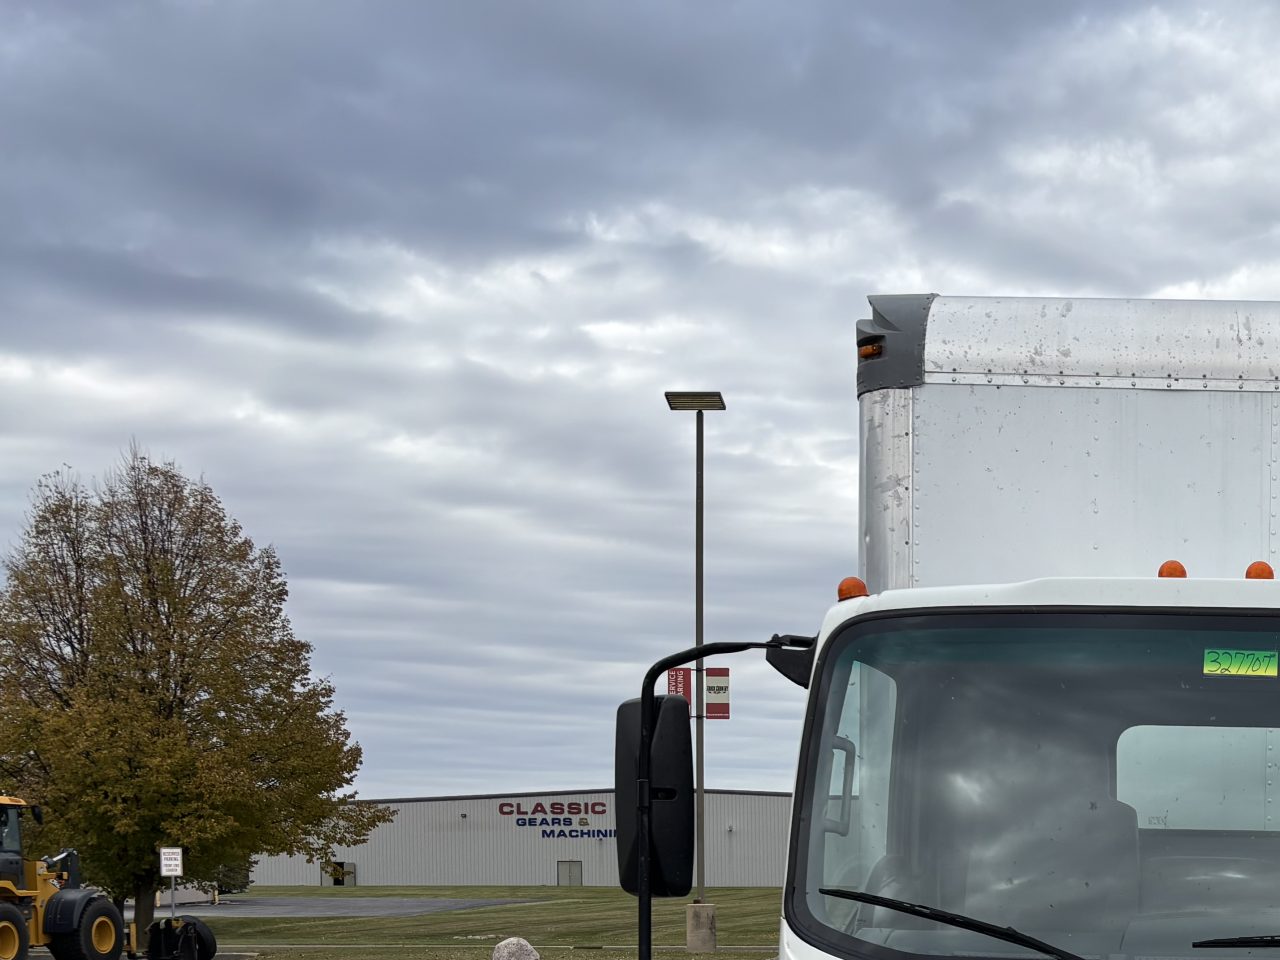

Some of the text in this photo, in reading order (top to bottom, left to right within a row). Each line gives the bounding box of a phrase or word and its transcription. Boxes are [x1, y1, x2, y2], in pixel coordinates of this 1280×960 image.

[498, 802, 607, 816] CLASSIC
[516, 817, 590, 827] GEARS &
